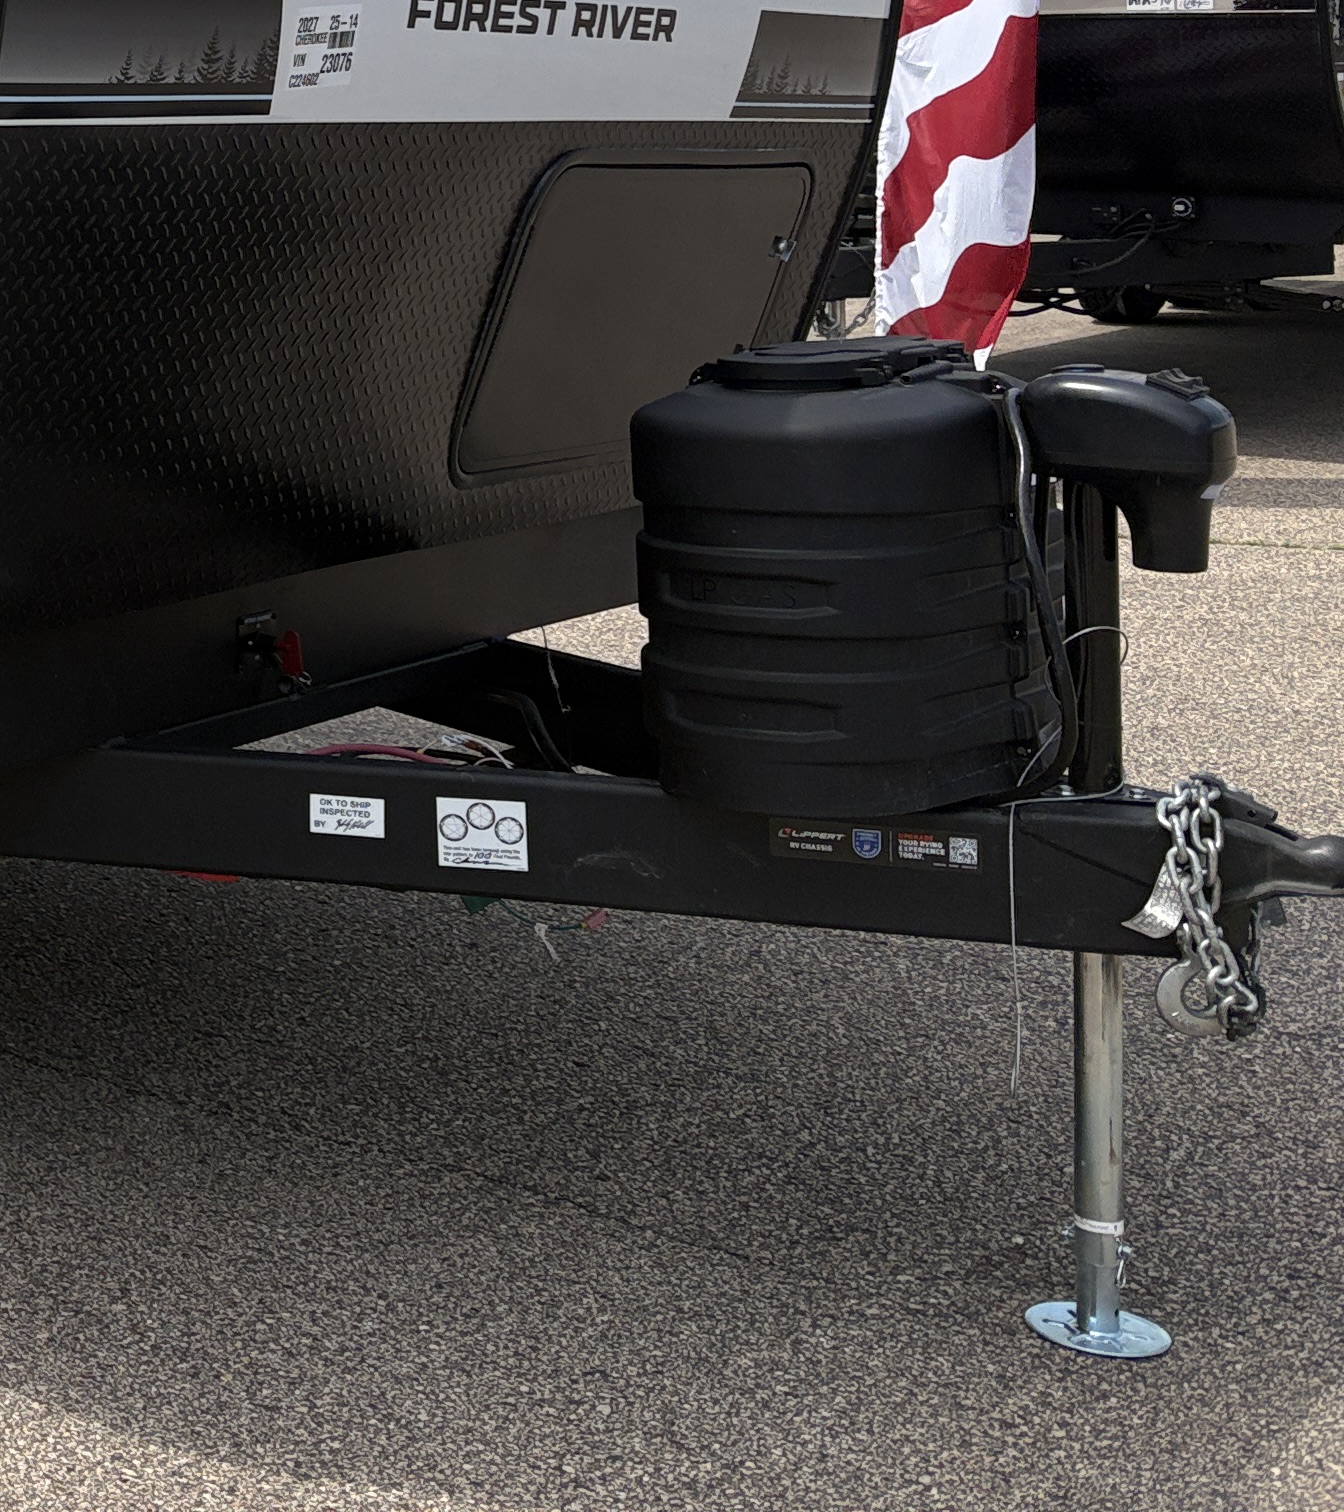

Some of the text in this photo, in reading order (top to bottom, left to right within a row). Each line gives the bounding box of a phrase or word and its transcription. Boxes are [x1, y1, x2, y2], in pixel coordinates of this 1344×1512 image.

[297, 13, 359, 33] 2027 25-14
[571, 2, 678, 42] RIVER
[293, 53, 307, 67] VIN
[320, 52, 353, 74] 23076
[319, 798, 372, 809] OK TO SHIP
[319, 807, 371, 819] INSPECTED
[313, 819, 327, 828] BY
